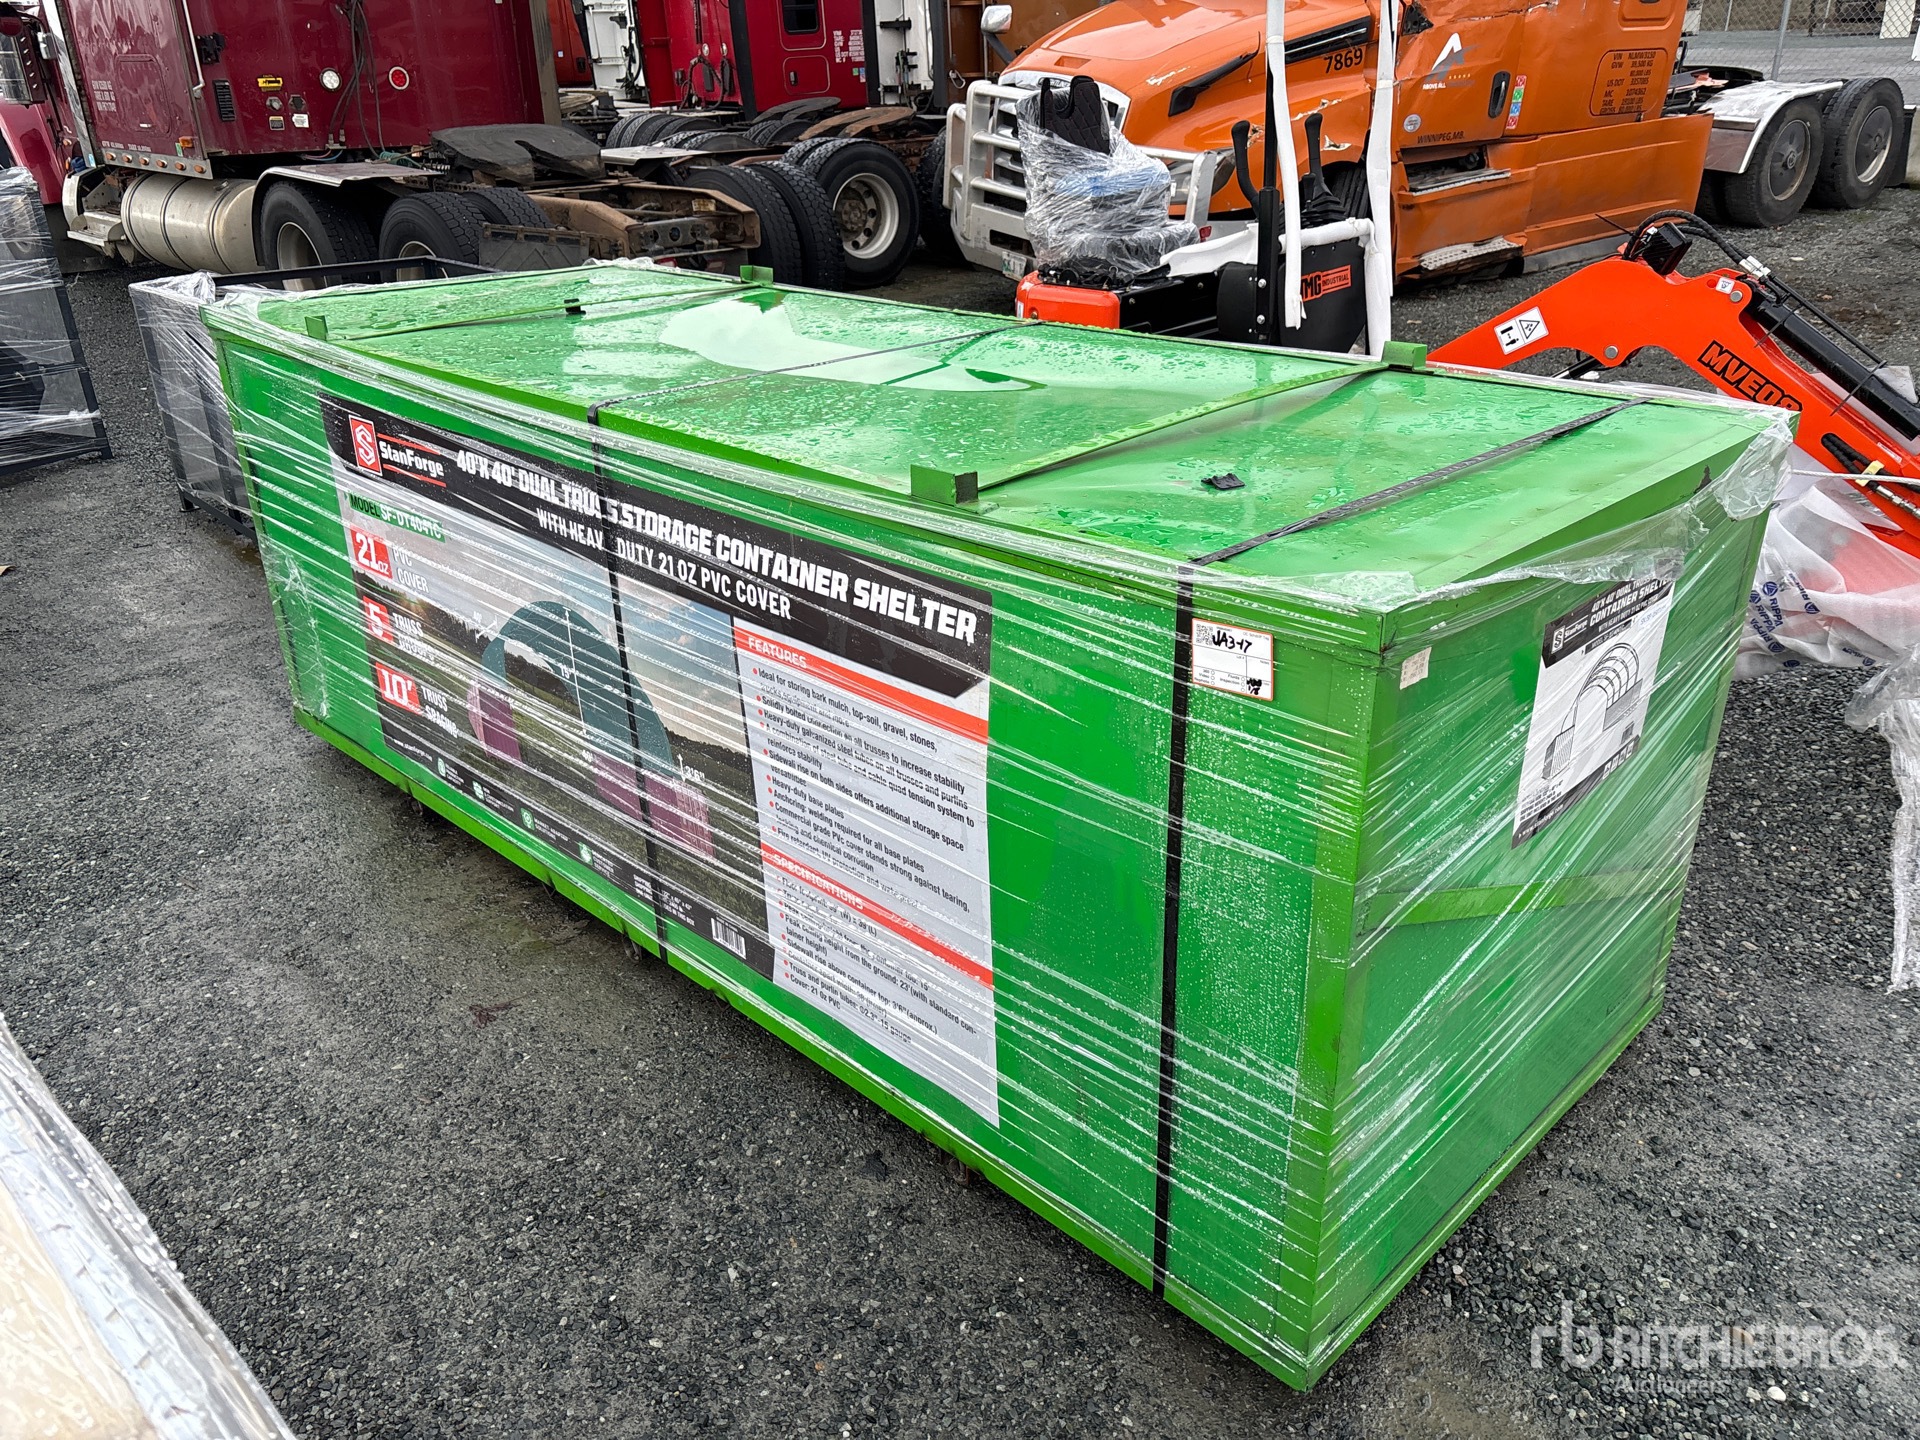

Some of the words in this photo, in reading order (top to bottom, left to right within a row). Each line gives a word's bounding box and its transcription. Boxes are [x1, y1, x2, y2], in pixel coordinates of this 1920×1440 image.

[1324, 47, 1363, 73] 7869
[1422, 82, 1438, 90] ABOVE
[1322, 273, 1350, 287] INDUSTRIAL
[377, 439, 445, 481] StanForge
[350, 494, 380, 517] MODEL
[488, 458, 517, 490] 40'
[515, 467, 560, 506] DUAL
[620, 501, 712, 559] STORAGE
[713, 531, 849, 605] CONTAINER
[851, 574, 977, 647] SHELTER
[535, 507, 568, 539] WITH
[567, 519, 605, 553] HEAV
[615, 535, 656, 571] DUTY
[656, 550, 674, 577] 21
[676, 556, 698, 586] OZ
[699, 565, 732, 599] PVC
[734, 578, 791, 621] COVER
[395, 564, 430, 596] COVER
[1616, 583, 1631, 598] DUAL
[366, 600, 386, 639] 5
[391, 608, 425, 642] TRUSS
[1564, 618, 1587, 639] StanForge
[1590, 591, 1638, 627] CONTAINER
[1755, 604, 1775, 632] RIPPA
[1769, 597, 1783, 627] RIPPA
[747, 634, 807, 670] FEATURES
[378, 662, 419, 717] 10'
[420, 684, 449, 713] TRUSS
[758, 667, 775, 683] Ideal
[776, 674, 786, 687] for
[787, 679, 811, 699] storing
[811, 688, 827, 704] bark
[828, 695, 851, 716] mulch,
[851, 706, 881, 729] top-soil,
[882, 719, 908, 741] gravel,
[909, 731, 938, 753] stones,
[761, 694, 784, 714] Solidly
[785, 704, 806, 722] bolted
[863, 740, 890, 761] trusses
[891, 752, 899, 764] to
[900, 756, 932, 780] increase
[933, 770, 965, 796] stability
[763, 708, 801, 735] Heavy-duty
[801, 725, 836, 750] galvanized
[836, 741, 853, 757] steel
[885, 763, 895, 777] all
[924, 781, 939, 798] and
[940, 788, 968, 812] purlins
[767, 736, 796, 757] reinforce
[796, 748, 823, 771] stability
[768, 748, 796, 770] Sidewall
[796, 761, 809, 776] rise
[810, 769, 819, 781] on
[819, 772, 834, 788] both
[835, 780, 853, 798] sides
[853, 789, 874, 808] offers
[875, 800, 911, 826] additional
[911, 818, 940, 842] storage
[941, 833, 964, 854] space
[771, 775, 807, 802] Heavy-duty
[808, 793, 823, 809] base
[824, 801, 845, 821] plates
[888, 779, 907, 798] quad
[908, 788, 935, 811] tension
[937, 802, 964, 825] system
[966, 815, 975, 829] to
[772, 788, 807, 815] Anchoring:
[807, 805, 833, 828] welding
[833, 819, 861, 842] required
[862, 833, 873, 847] for
[873, 839, 883, 852] all
[884, 844, 901, 862] base
[902, 853, 925, 875] plates
[777, 826, 790, 840] Fire
[799, 826, 812, 841] and
[812, 833, 842, 856] chemical
[842, 849, 874, 873] corrosion
[774, 801, 811, 828] Commercial
[812, 820, 831, 840] grade
[845, 837, 864, 855] cover
[864, 847, 888, 868] stands
[889, 860, 913, 882] strong
[913, 872, 941, 897] against
[941, 887, 970, 914] tearing,
[785, 924, 804, 944] tainer
[804, 935, 828, 957] height)
[784, 913, 801, 929] Peak
[844, 947, 860, 963] from
[861, 956, 872, 971] the
[872, 963, 899, 988] ground:
[928, 996, 959, 1026] standard
[960, 1018, 977, 1037] con-
[788, 960, 806, 979] Truss
[806, 970, 820, 986] and
[820, 978, 839, 999] purlin
[839, 991, 858, 1011] tubes:
[789, 971, 809, 992] Cover:
[810, 984, 818, 997] 21
[827, 994, 841, 1011] PVC
[814, 952, 826, 967] rise
[827, 959, 846, 979] above
[846, 972, 877, 999] container
